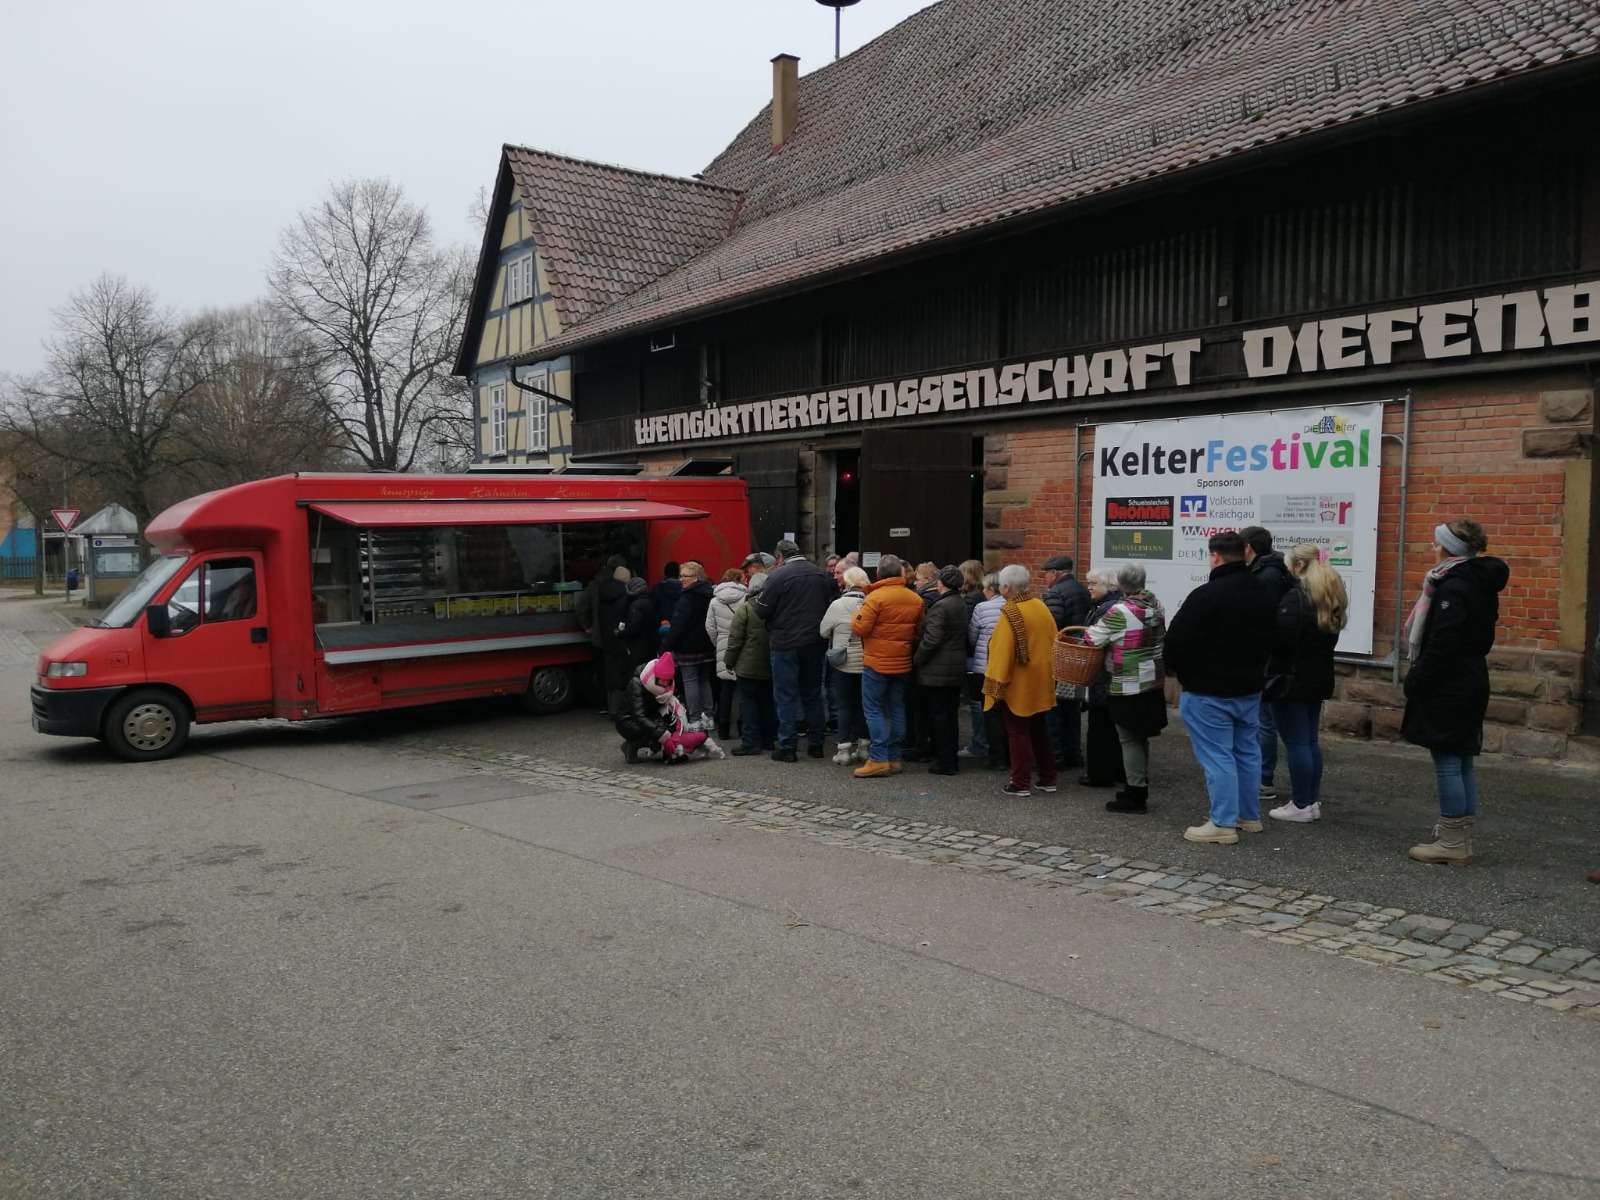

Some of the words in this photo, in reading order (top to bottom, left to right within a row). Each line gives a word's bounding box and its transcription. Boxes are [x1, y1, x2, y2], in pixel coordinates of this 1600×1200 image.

[634, 338, 1200, 445] WEINGÄRTNERGENOSSENSCHAFT
[1101, 429, 1370, 477] KelterFestival
[1197, 478, 1244, 489] Sponsoren
[1210, 495, 1254, 506] Volksbank
[1210, 509, 1255, 521] Kraichgau
[1273, 535, 1330, 544] fen-Autoservice
